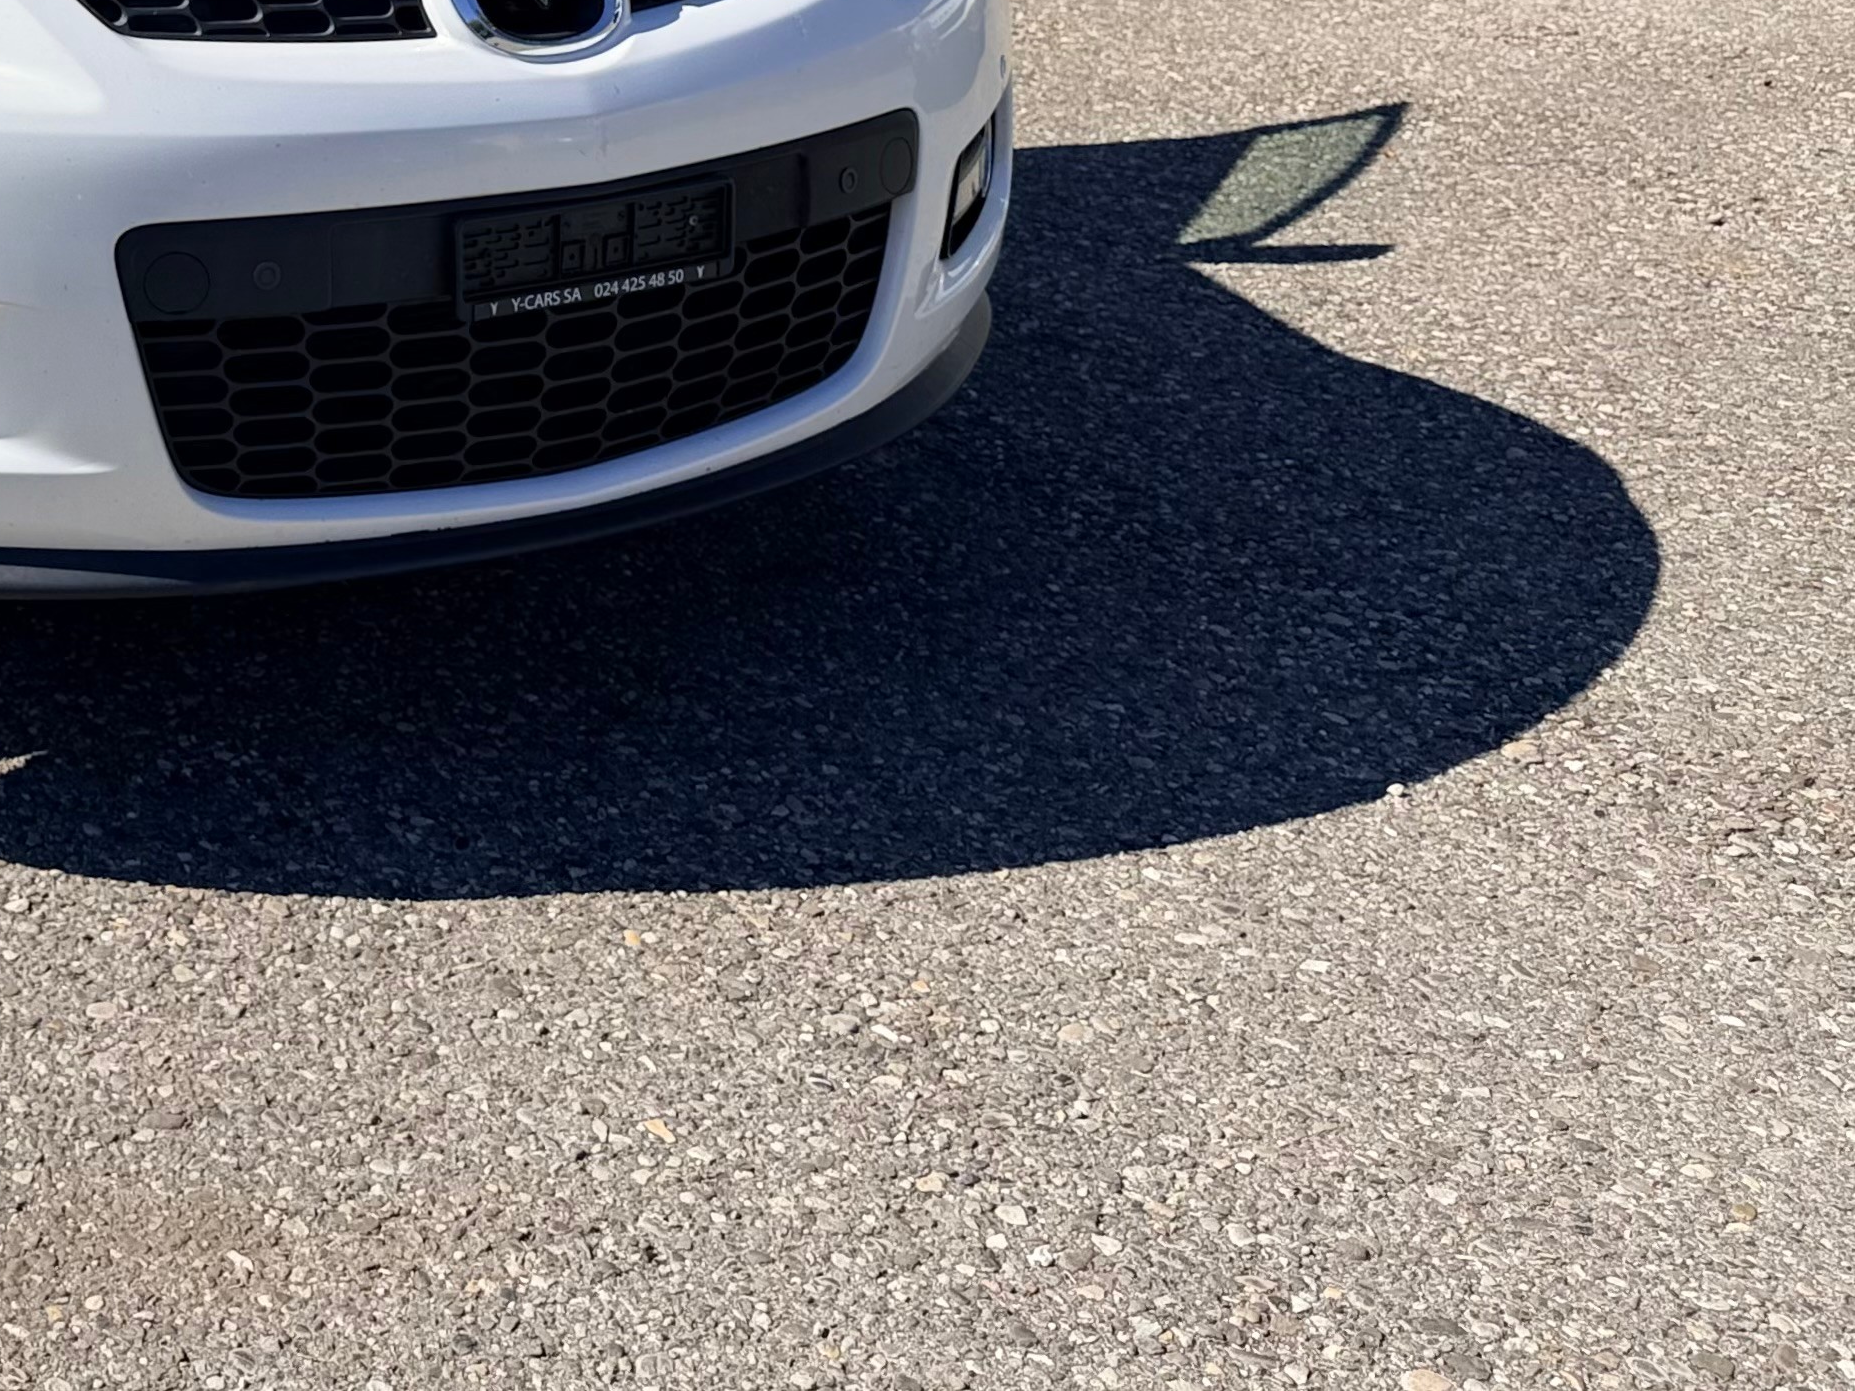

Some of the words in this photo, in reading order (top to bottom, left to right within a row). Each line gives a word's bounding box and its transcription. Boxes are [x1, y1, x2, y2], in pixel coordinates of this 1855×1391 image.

[511, 290, 561, 313] Y-CARS
[563, 287, 582, 304] SA
[594, 281, 619, 298] 024
[621, 275, 646, 293] 425
[649, 272, 665, 288] 48
[668, 268, 684, 285] 50
